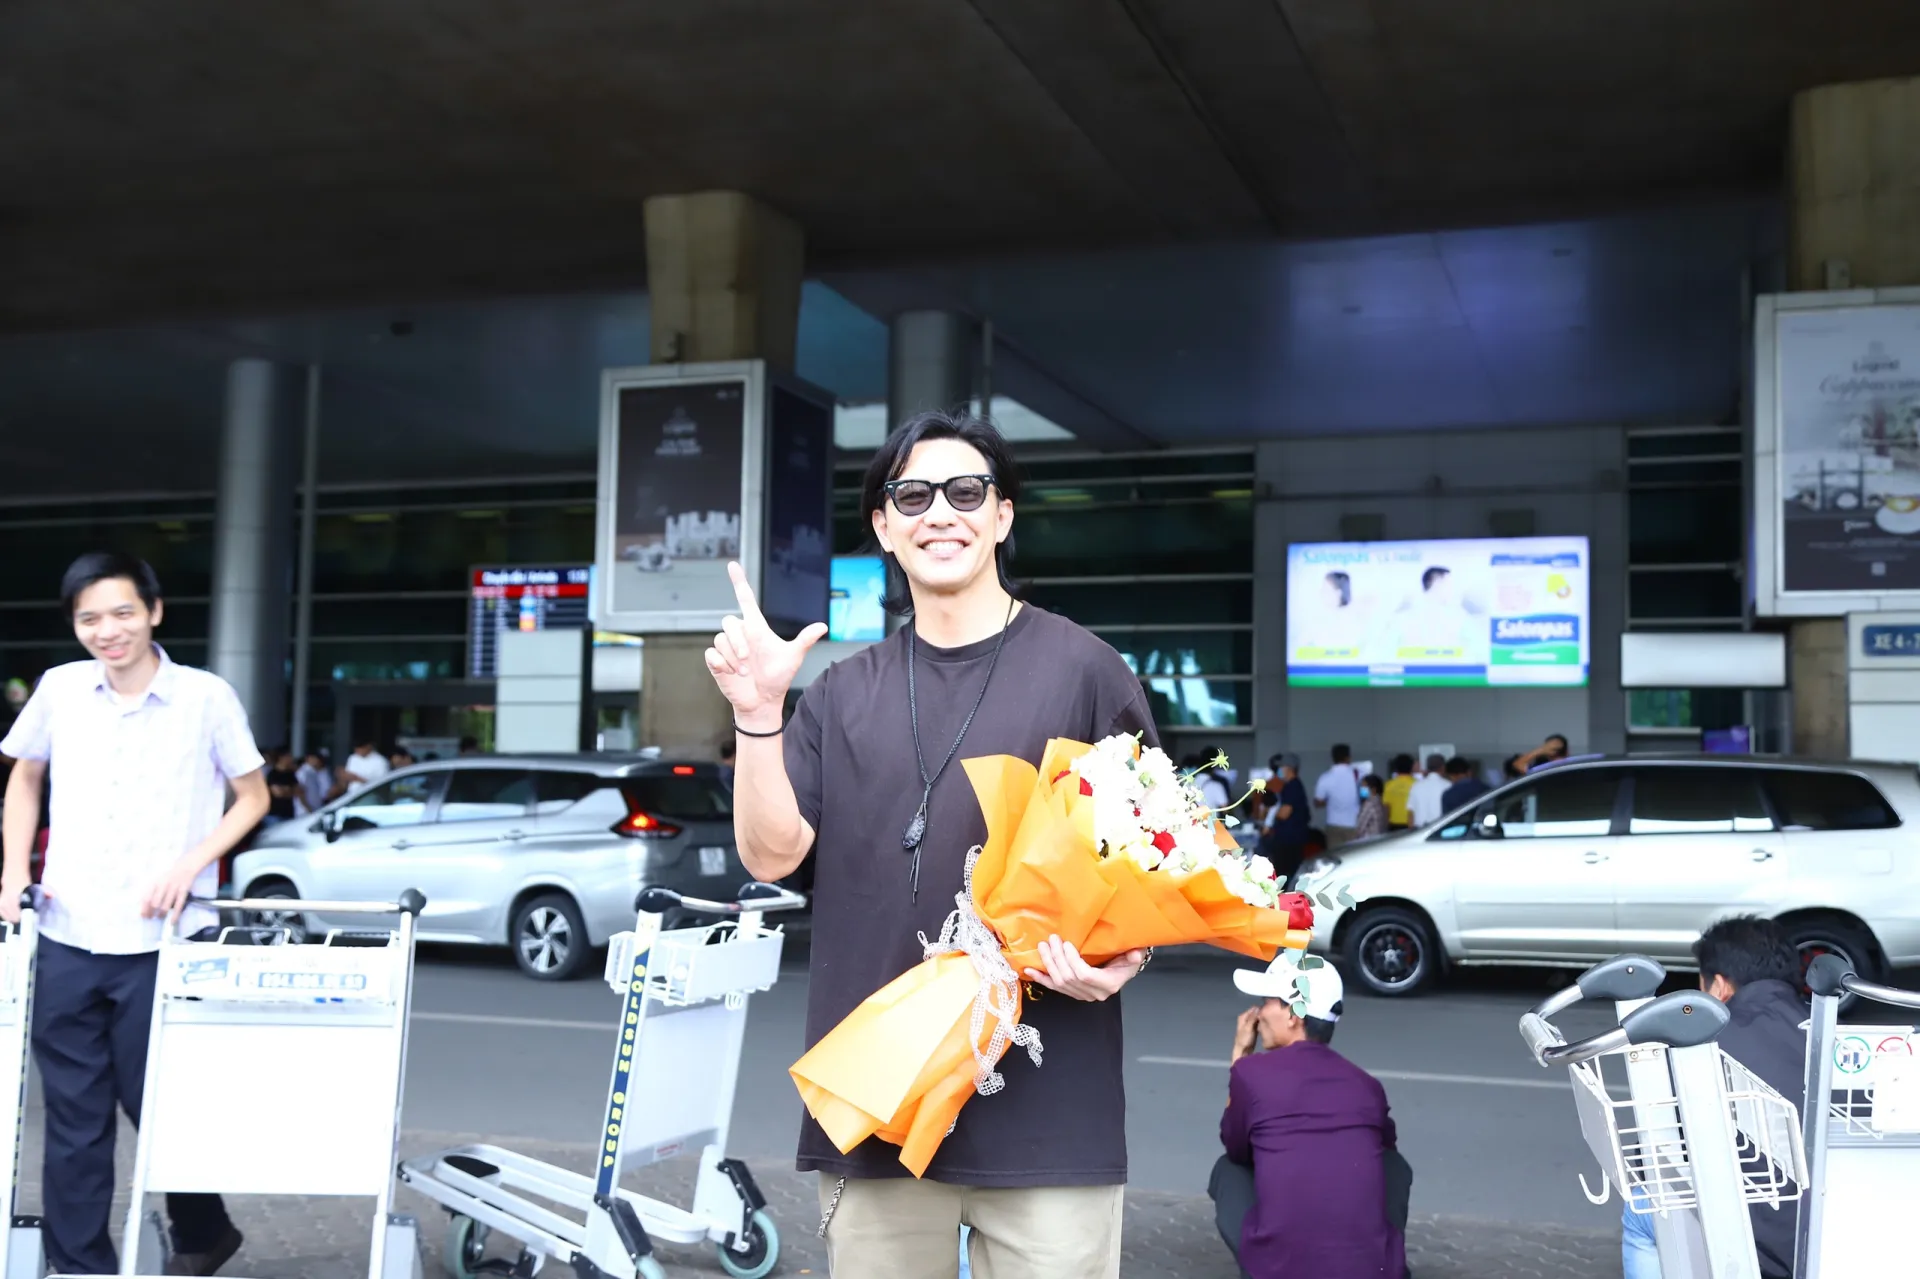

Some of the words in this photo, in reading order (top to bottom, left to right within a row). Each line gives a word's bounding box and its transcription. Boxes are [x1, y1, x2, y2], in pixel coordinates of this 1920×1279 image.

[1496, 619, 1573, 641] Salonpas
[618, 964, 647, 1073] GOLDSUN
[603, 1091, 625, 1168] GROUP
